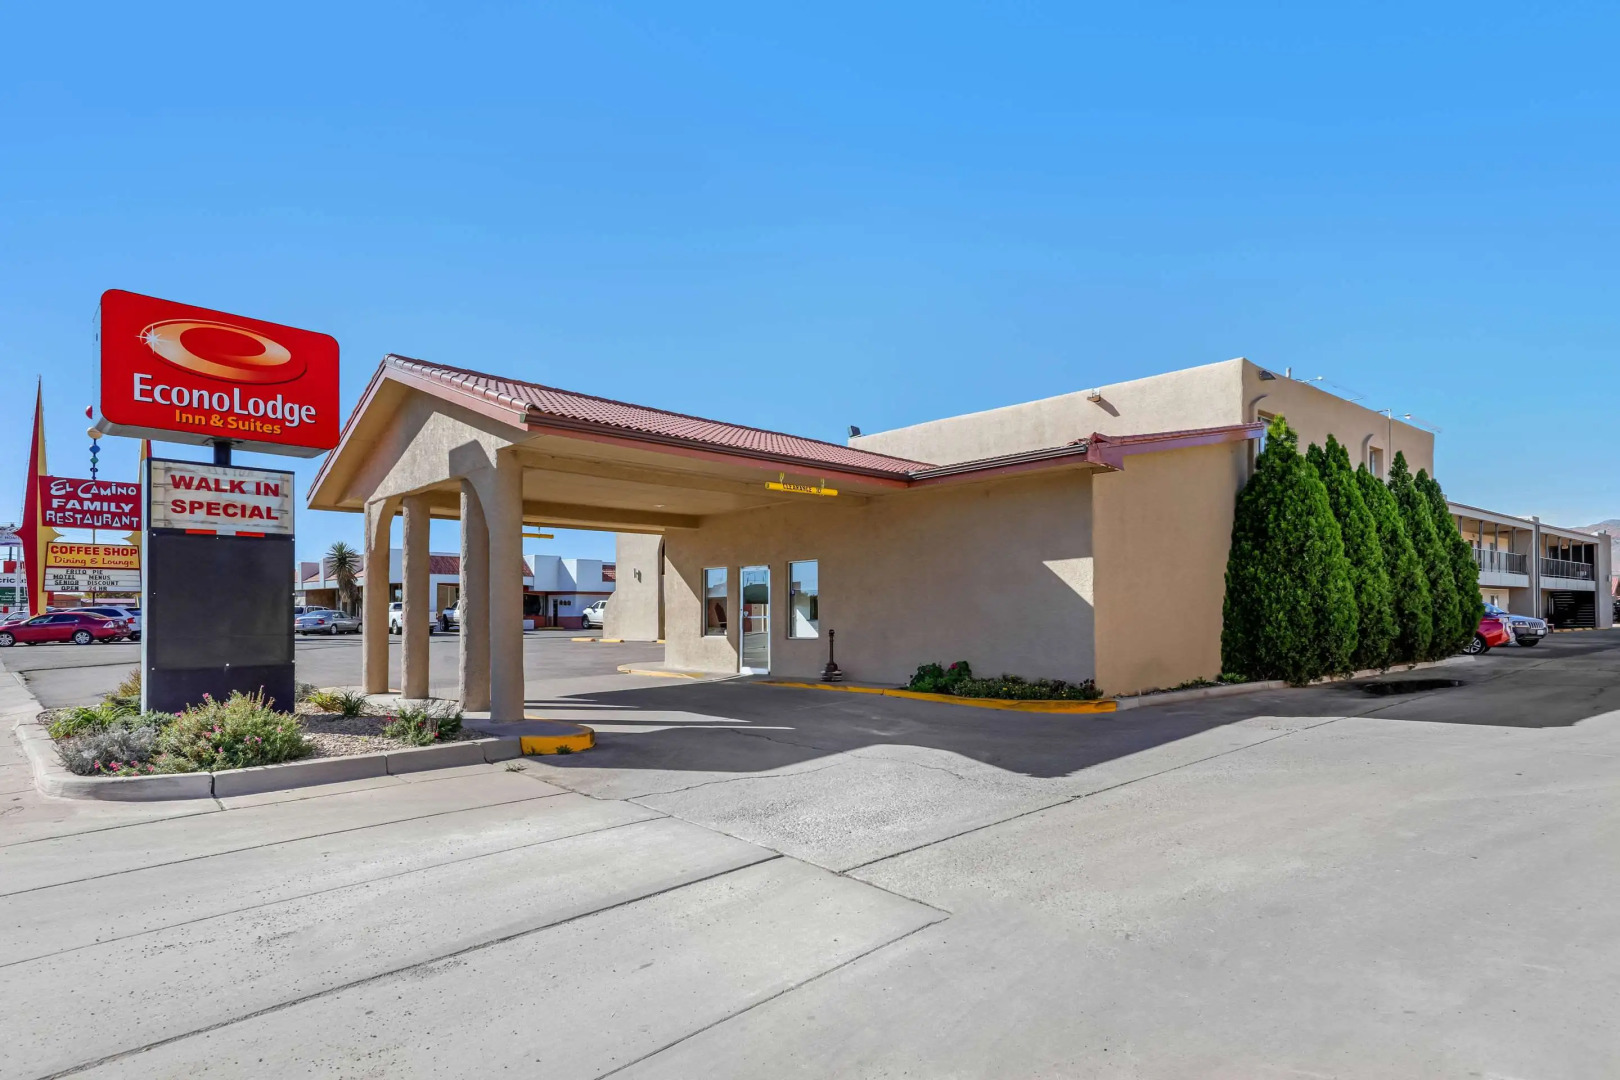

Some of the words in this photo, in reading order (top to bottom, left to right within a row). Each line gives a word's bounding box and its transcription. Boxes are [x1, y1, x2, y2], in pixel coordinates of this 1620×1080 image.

[175, 409, 206, 425] Inn
[210, 413, 224, 428] &
[227, 416, 282, 434] Suites
[170, 474, 246, 494] WALK
[255, 481, 280, 497] IN
[52, 498, 134, 513] FAMILY
[170, 499, 279, 520] SPECIAL
[46, 510, 139, 528] RESTAURANT
[50, 545, 100, 556] COFFEE
[103, 547, 137, 557] SHOP
[53, 555, 87, 566] Dining
[102, 558, 134, 568] Lounge
